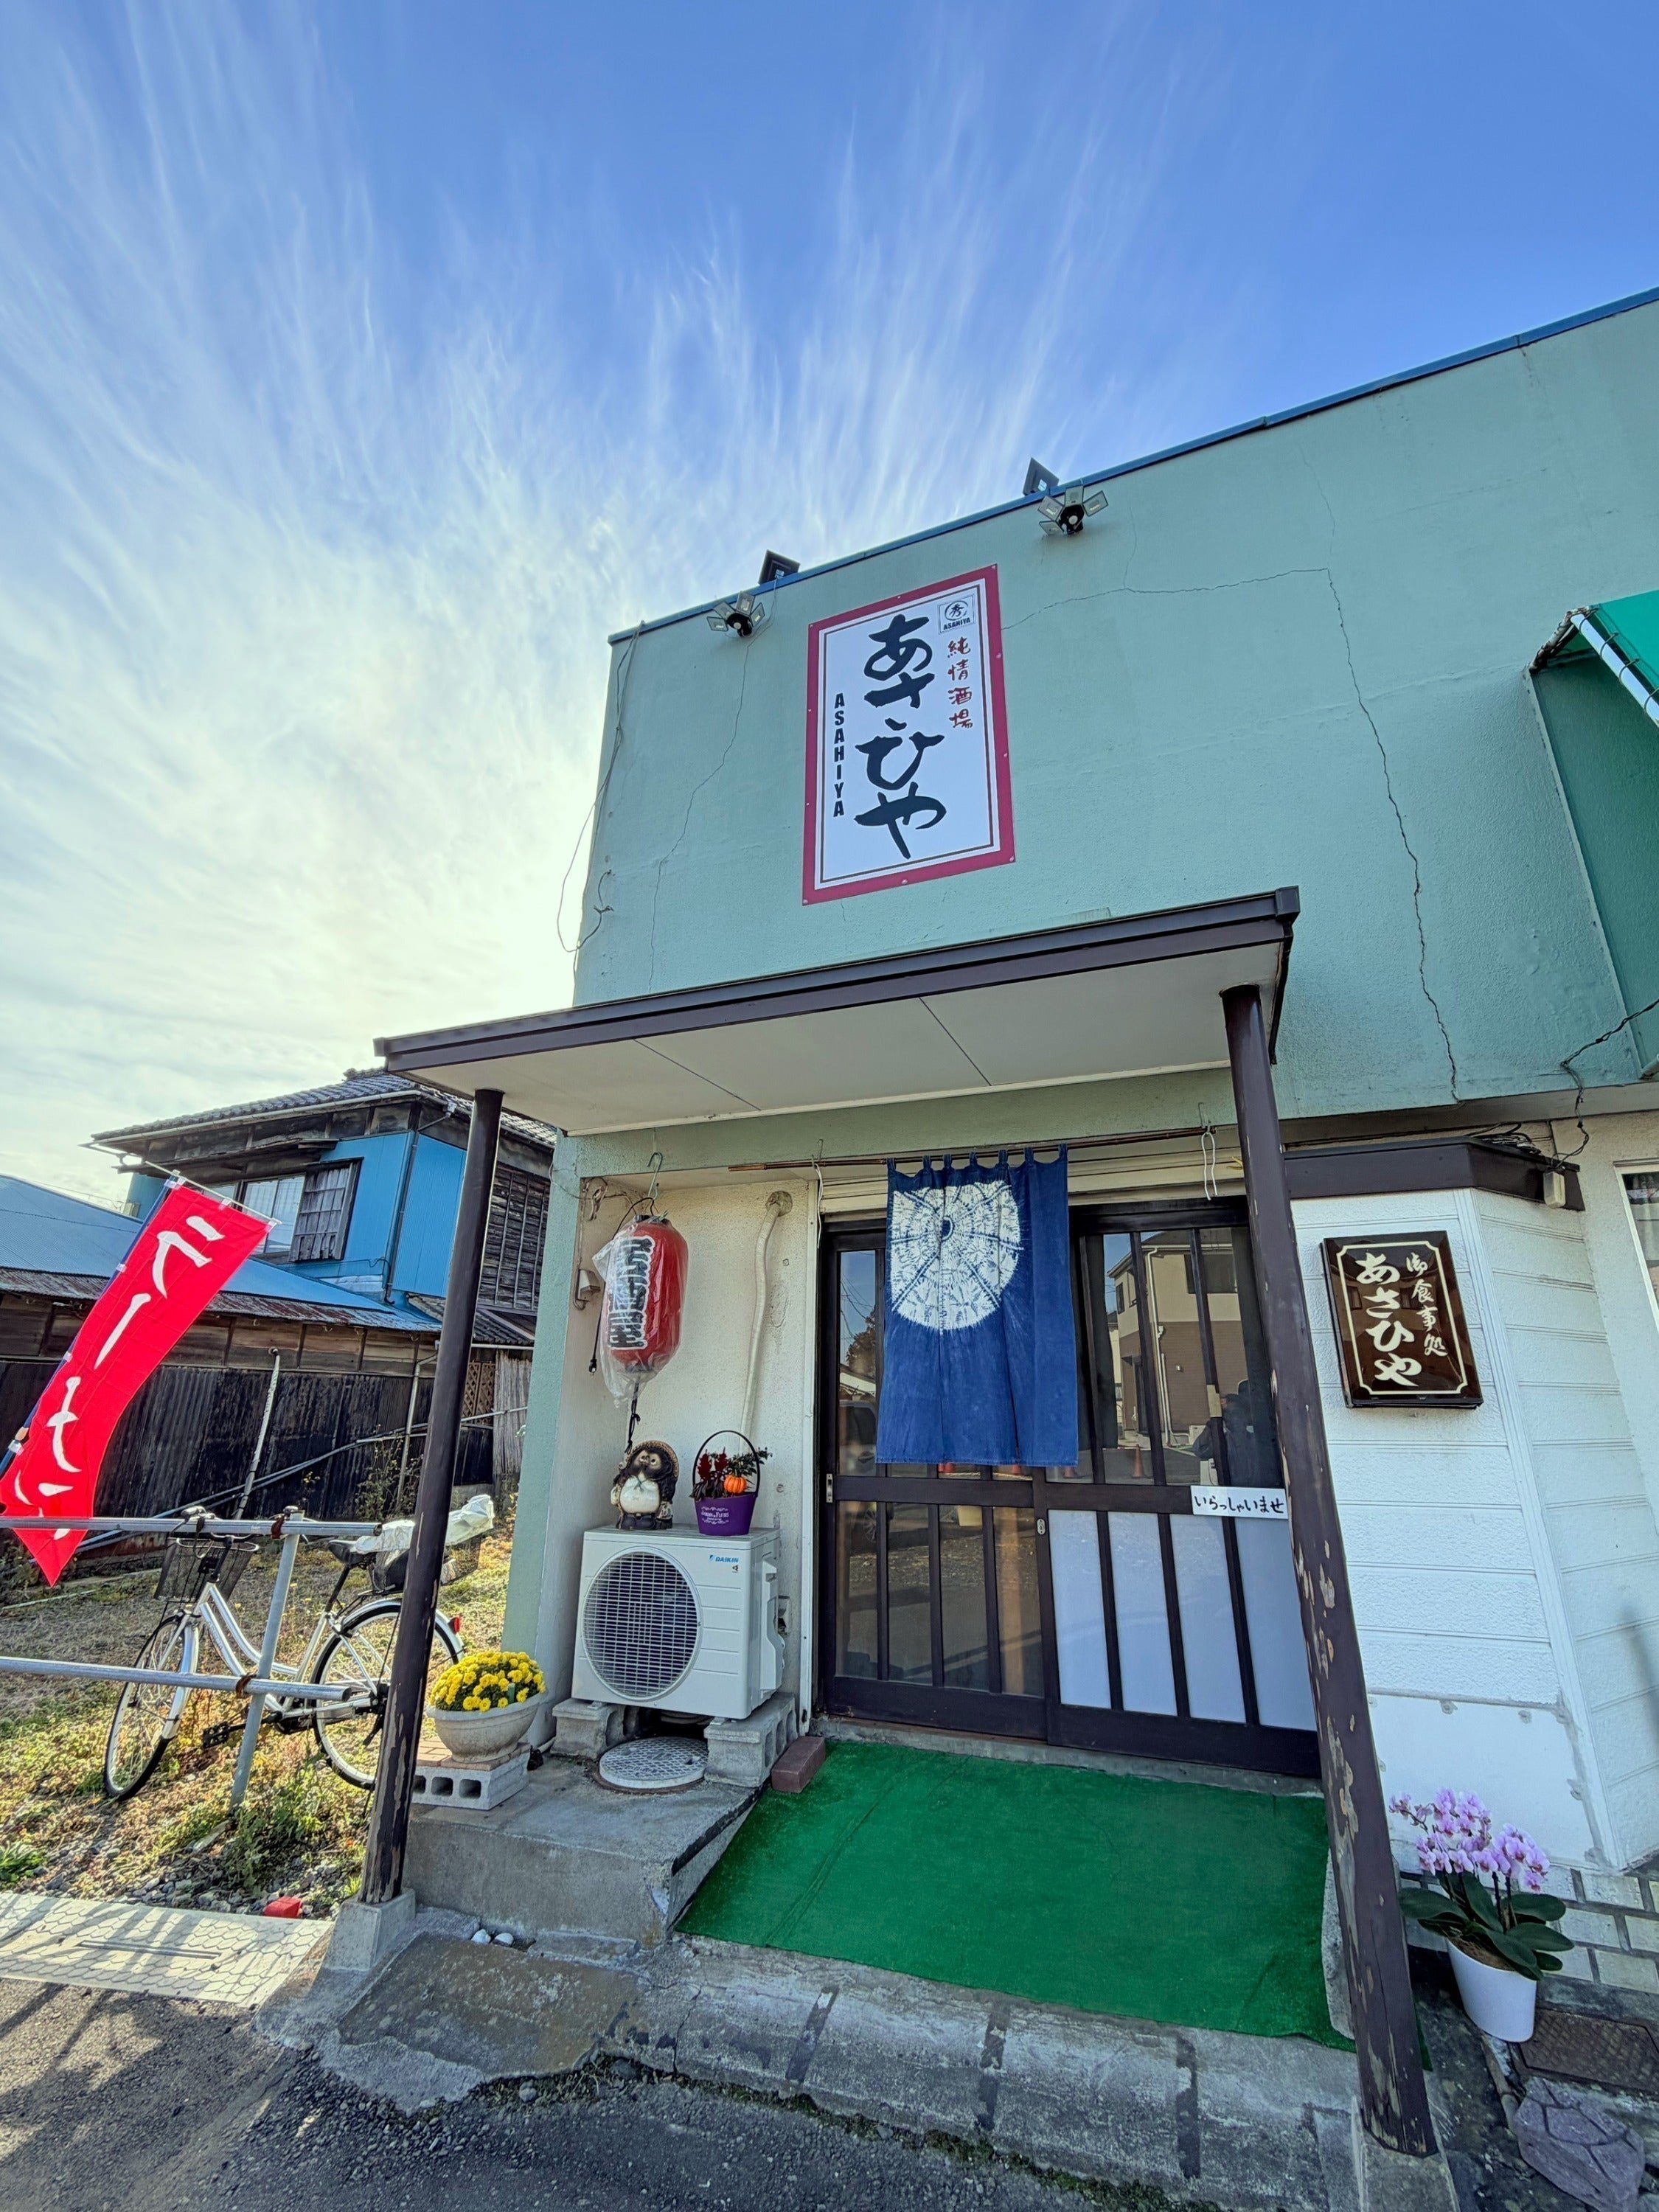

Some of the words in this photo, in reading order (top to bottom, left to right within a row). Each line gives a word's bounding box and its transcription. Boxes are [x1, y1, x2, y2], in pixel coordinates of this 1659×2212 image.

[943, 616, 971, 630] ASAHIYA
[947, 636, 973, 728] 純情酒場
[832, 692, 846, 818] ASAHIYA
[853, 613, 947, 860] あさひや
[1354, 1252, 1422, 1387] あさひや
[1405, 1252, 1448, 1357] 御食事処
[1194, 1495, 1284, 1514] いらっしゃいませ
